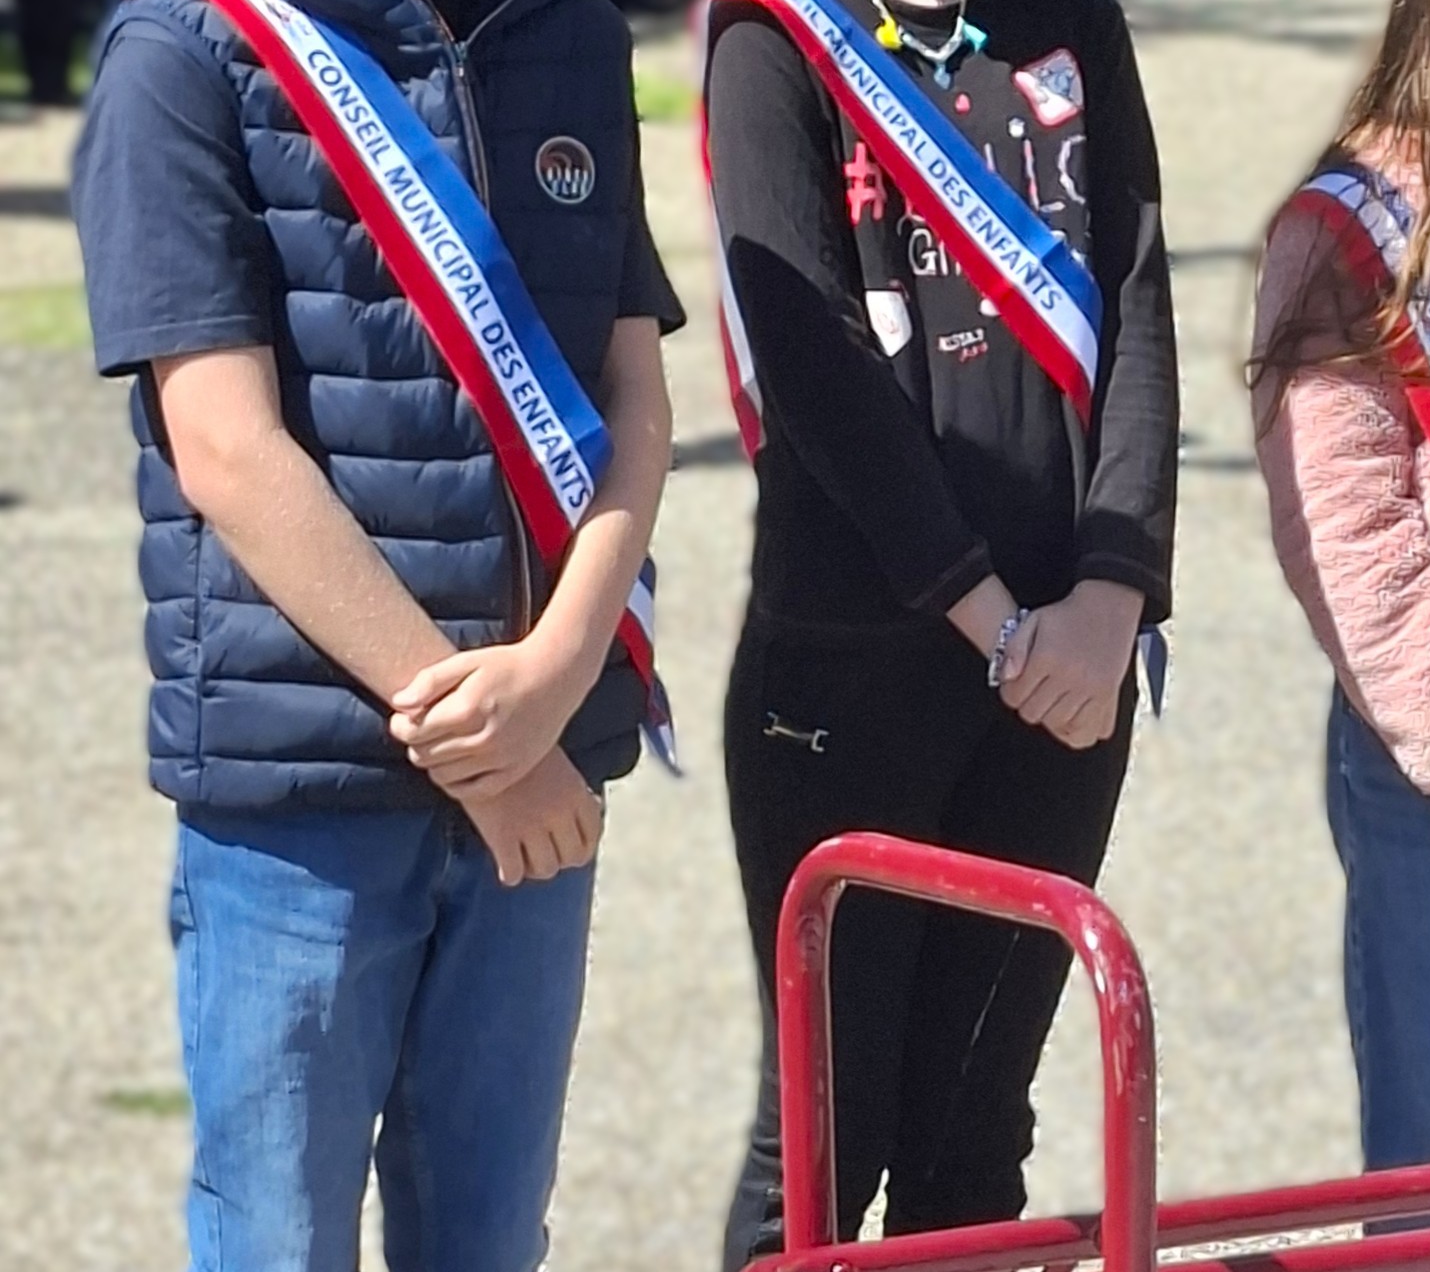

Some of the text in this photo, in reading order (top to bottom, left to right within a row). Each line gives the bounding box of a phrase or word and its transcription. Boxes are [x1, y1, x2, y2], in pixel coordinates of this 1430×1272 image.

[307, 49, 591, 508] CONSEIL MUNICIPAL DES ENFANTS
[823, 28, 927, 161] MUNICIPAL
[928, 159, 971, 207] DES
[967, 205, 1062, 310] ENFANTS
